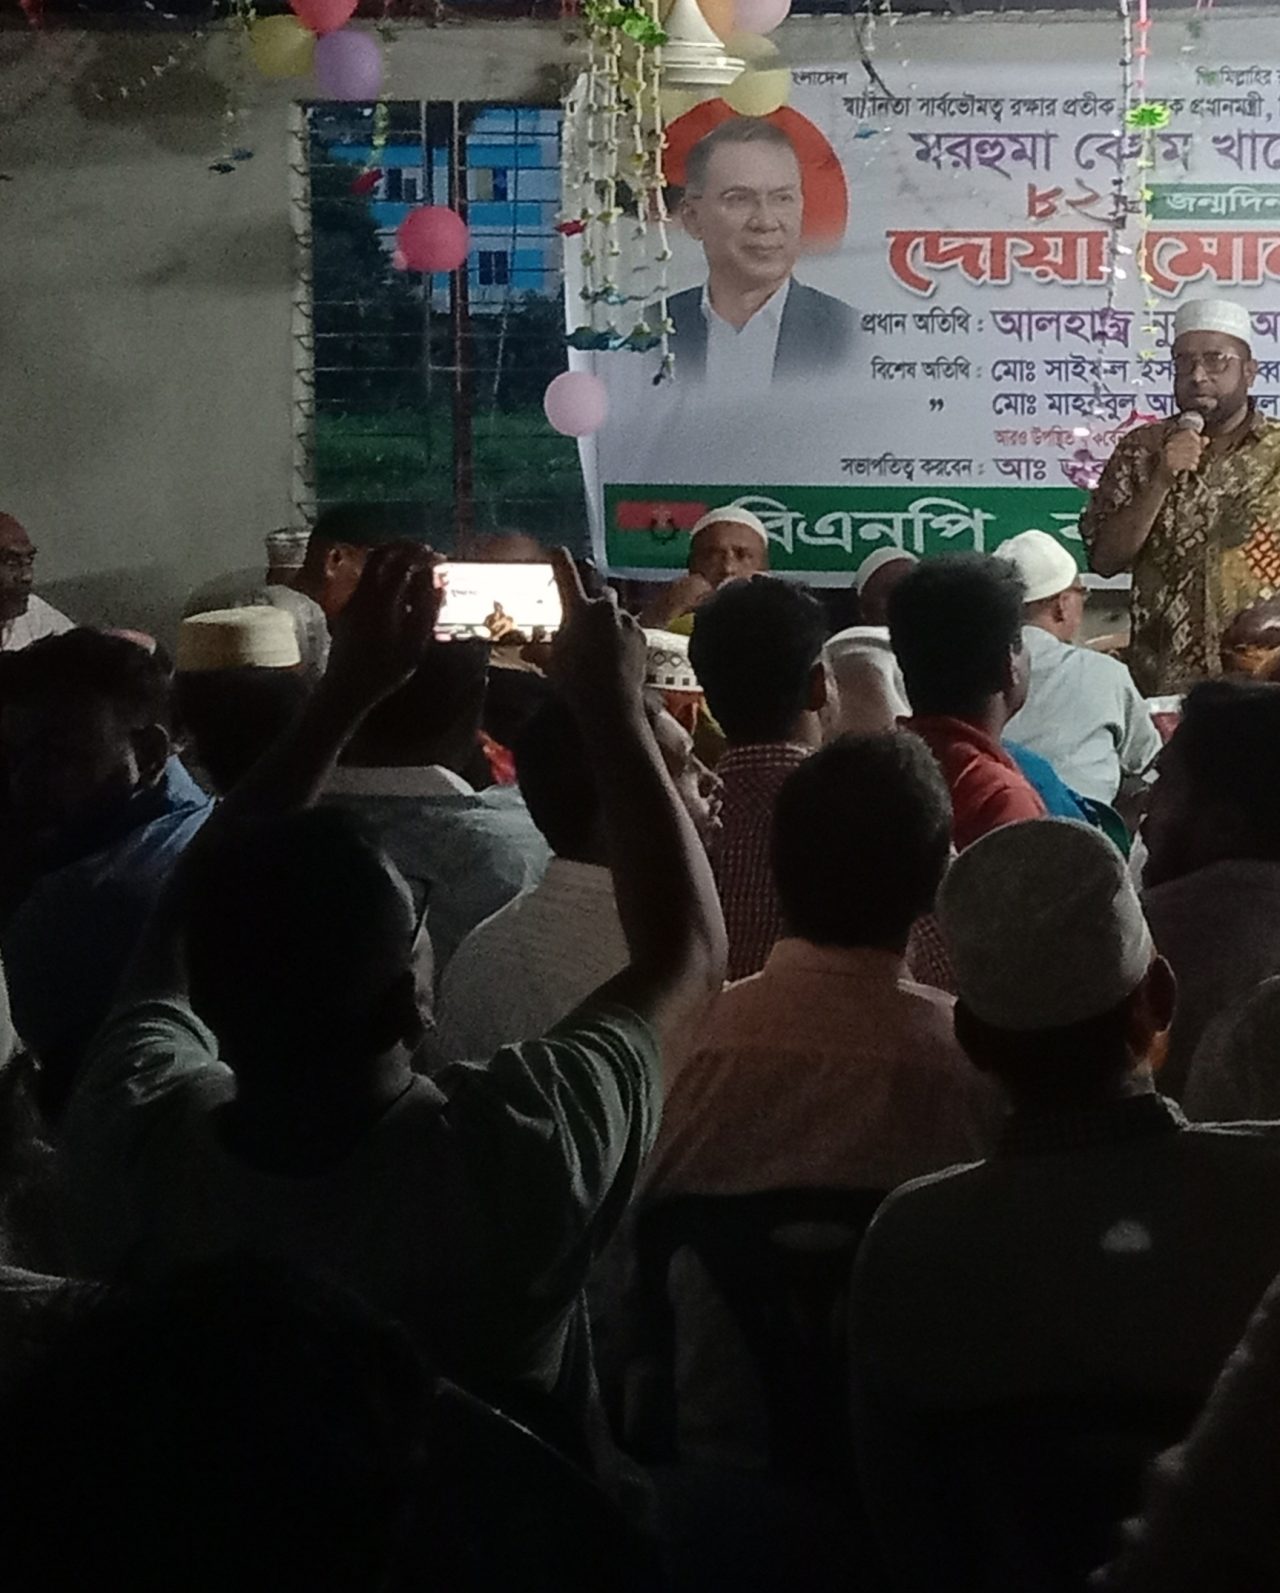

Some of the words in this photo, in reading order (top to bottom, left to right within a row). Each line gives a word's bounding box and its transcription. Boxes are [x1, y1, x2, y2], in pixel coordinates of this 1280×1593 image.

[916, 91, 1004, 123] সার্বভৌমত্ব
[1010, 98, 1057, 118] রক্ষার
[1062, 91, 1117, 118] প্রতীক
[909, 130, 1059, 178] মরহুমা
[886, 229, 1110, 297] দোয়া
[862, 312, 907, 335] প্রধান
[913, 306, 972, 335] অতিথি
[871, 355, 917, 380] বিশেষ
[921, 355, 972, 380] অতিথি
[991, 359, 1036, 383] মোঃ
[992, 393, 1036, 417] মোঃ
[840, 452, 916, 482] সভাপতিত্ব
[992, 458, 1047, 481] আঃ
